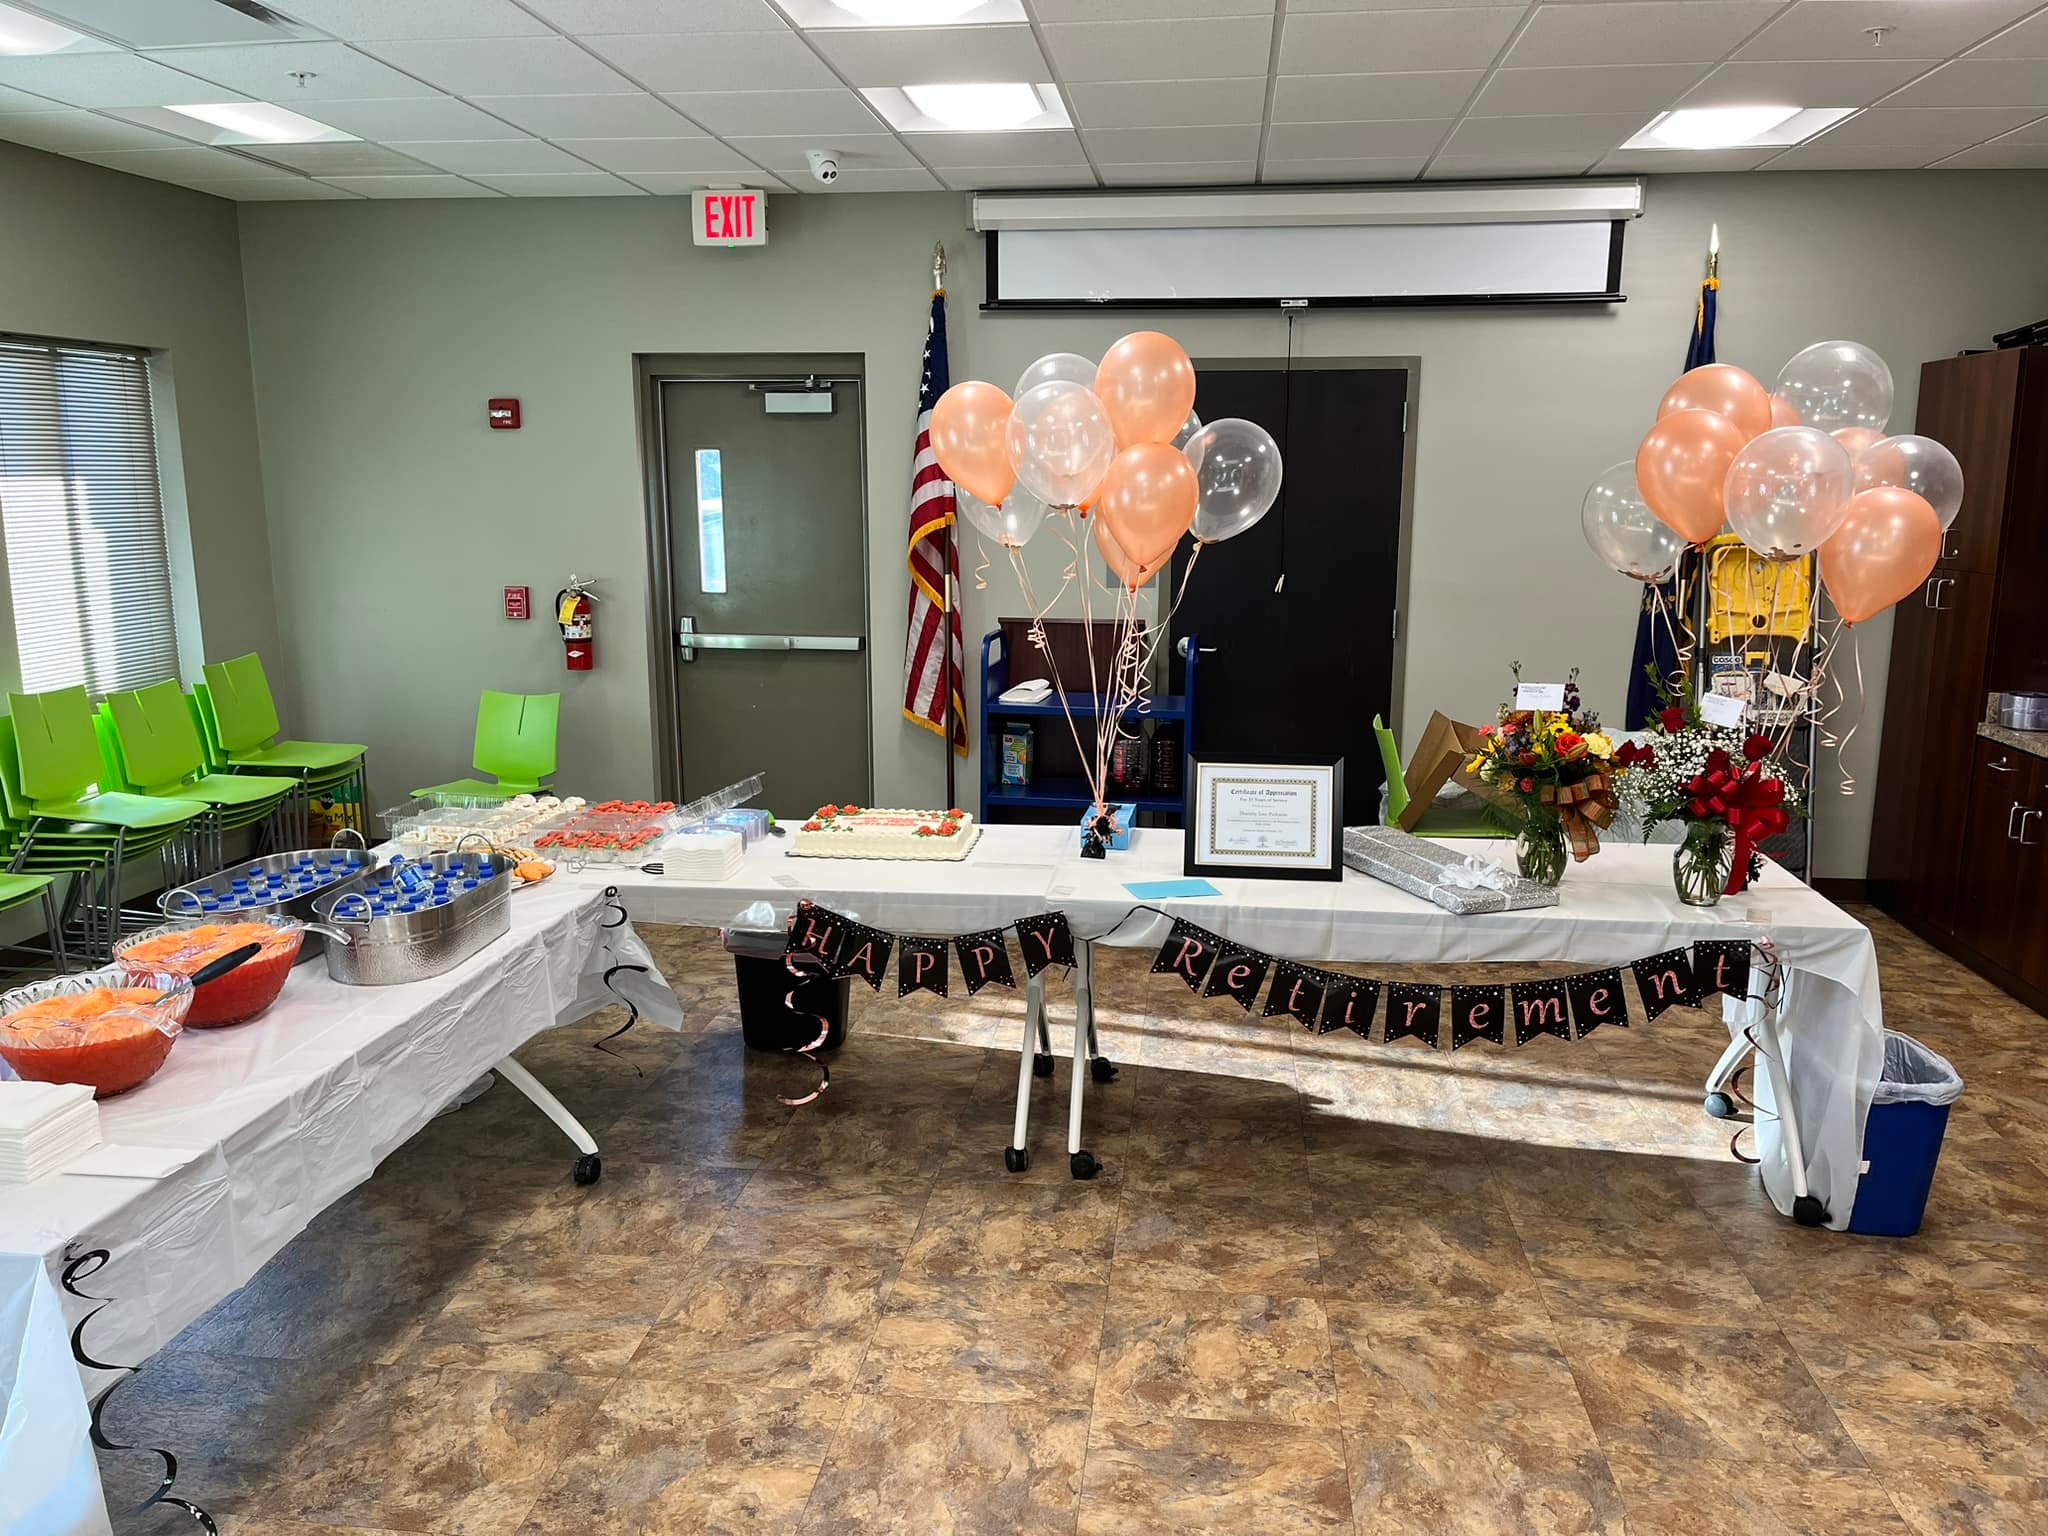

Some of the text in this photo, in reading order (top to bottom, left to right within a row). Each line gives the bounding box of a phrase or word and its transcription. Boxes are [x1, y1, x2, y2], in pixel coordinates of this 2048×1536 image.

[704, 195, 756, 238] EXIT
[802, 917, 1055, 984] HAPPY
[1172, 936, 1731, 1030] Retirement
